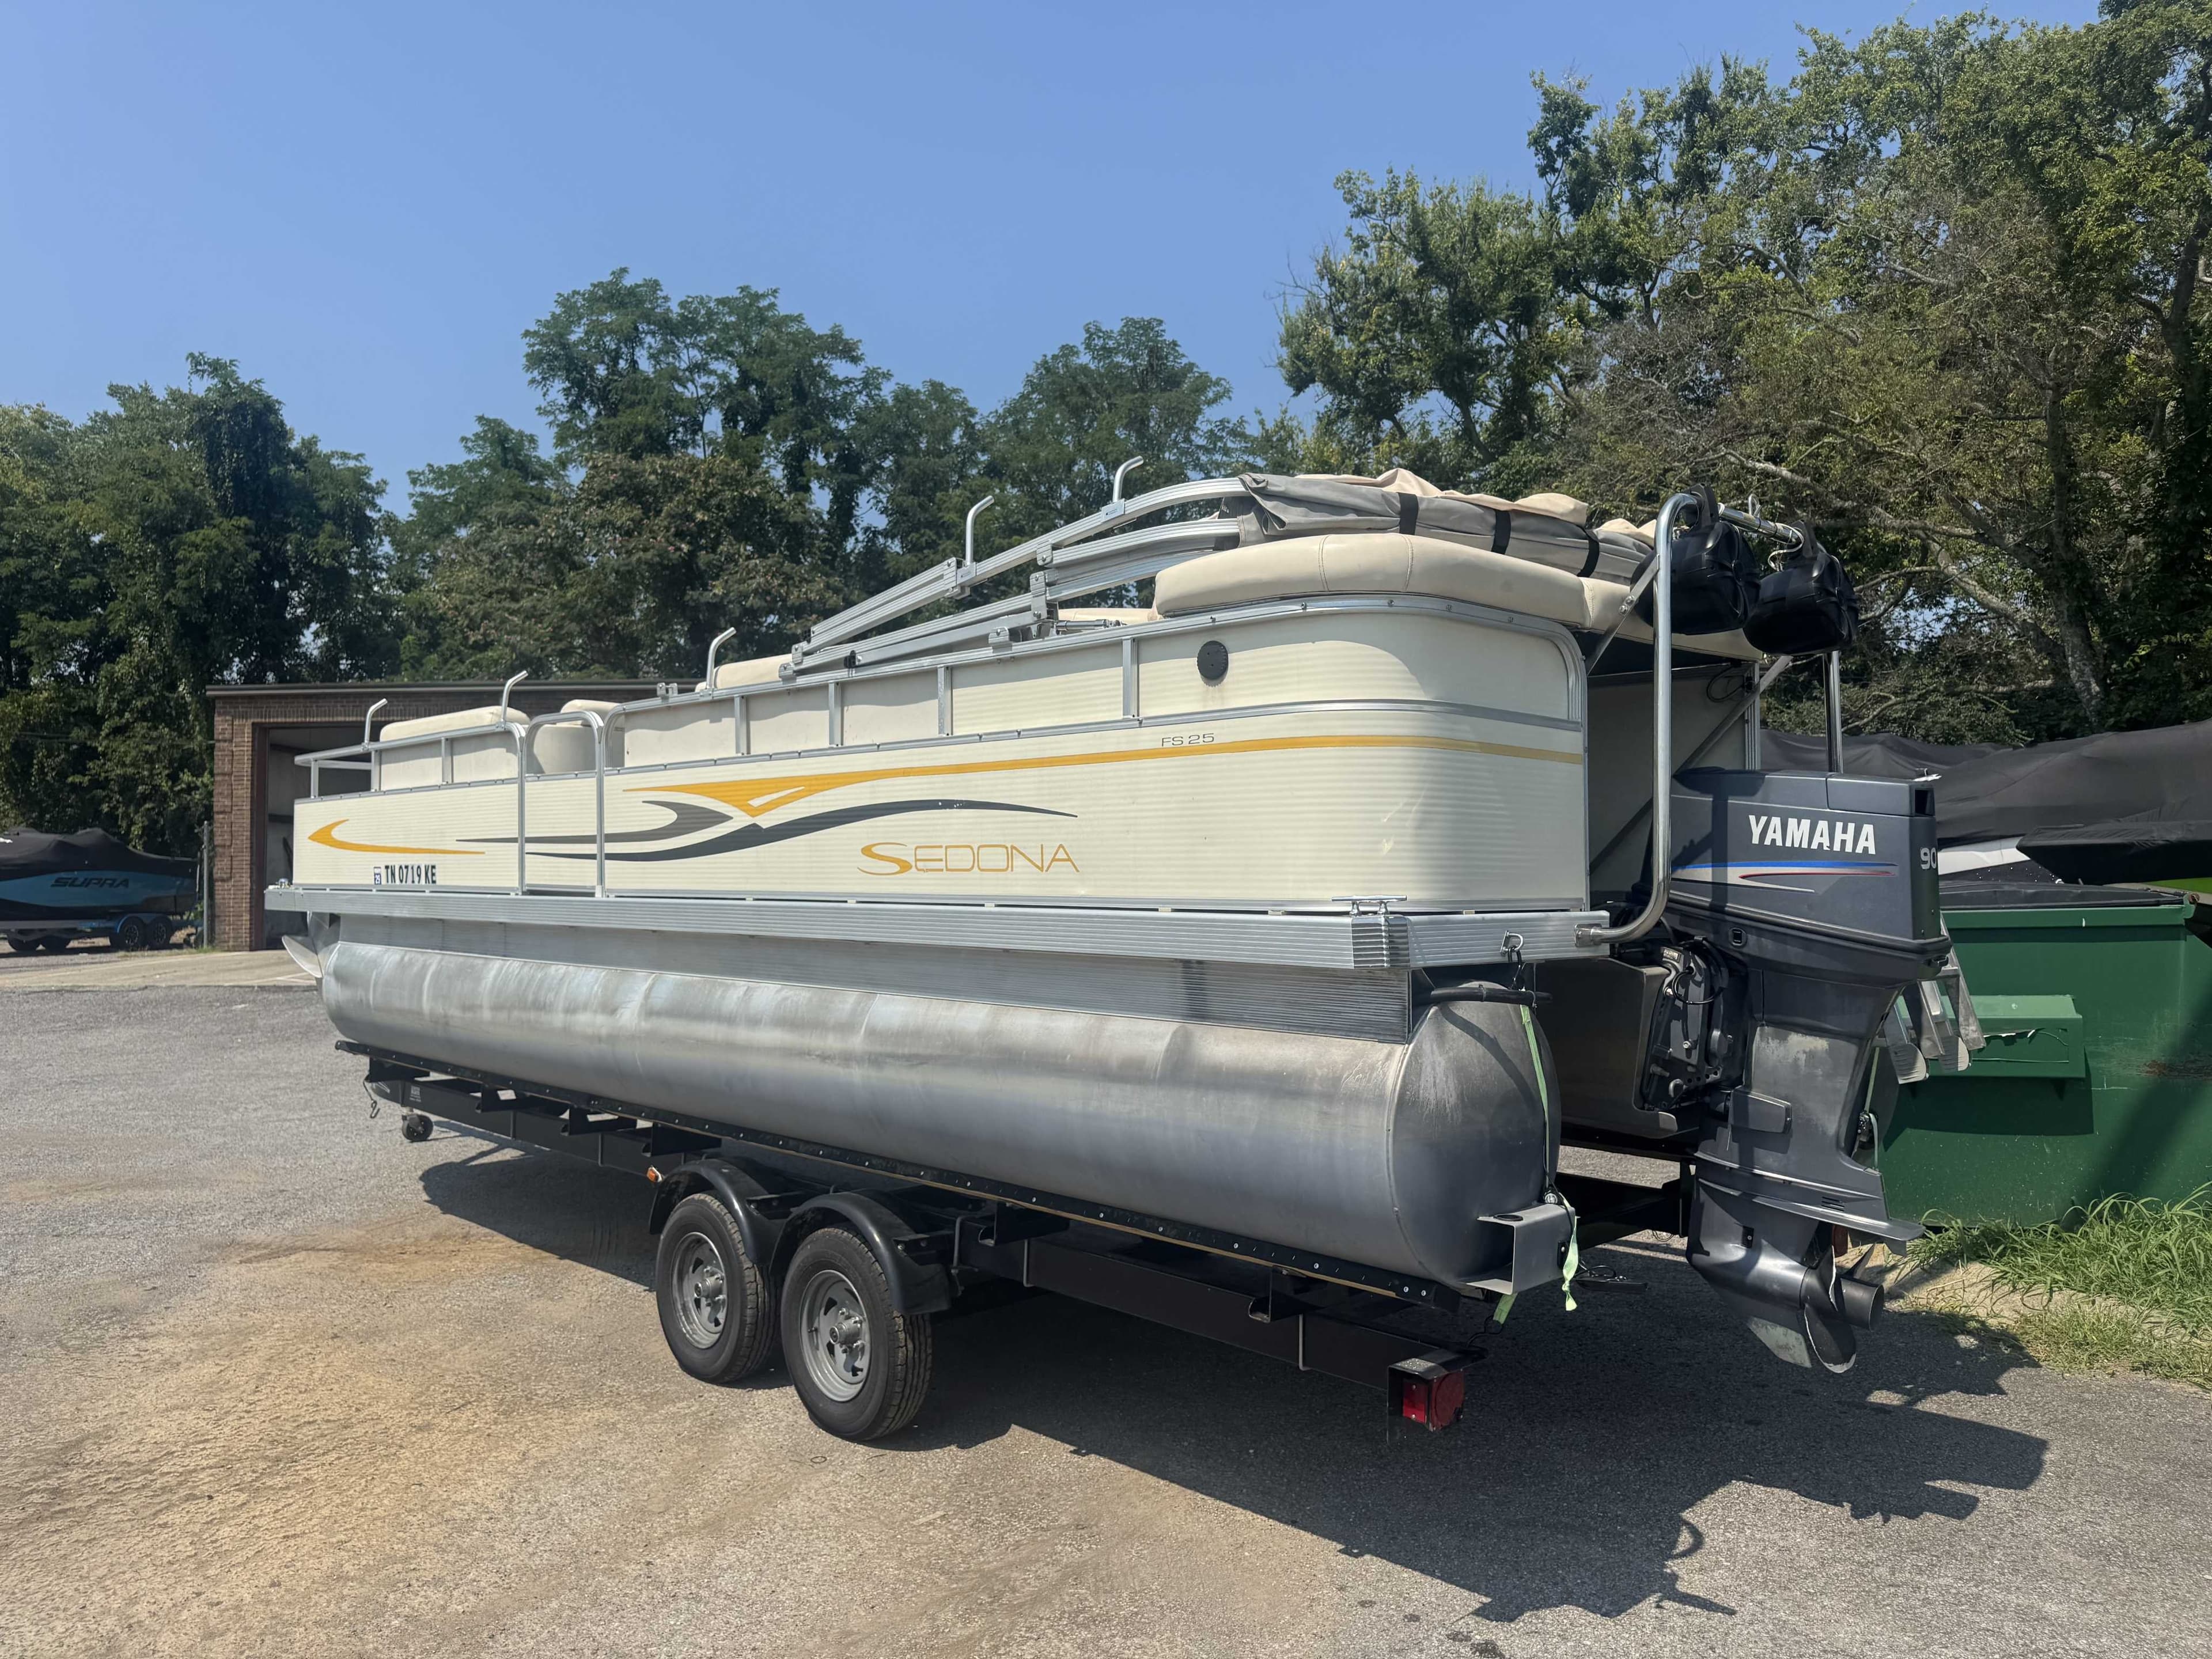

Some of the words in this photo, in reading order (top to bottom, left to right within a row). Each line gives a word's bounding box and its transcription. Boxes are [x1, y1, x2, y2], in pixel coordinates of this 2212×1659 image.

[1161, 736, 1183, 747] FS
[1188, 733, 1214, 744] 25
[1748, 815, 1876, 855] YAMAHA
[857, 842, 1080, 876] SEDONA
[1920, 847, 1937, 869] 90
[50, 877, 130, 888] SUPRA
[385, 865, 396, 884] TN
[399, 865, 422, 884] 0719
[425, 865, 437, 884] KE
